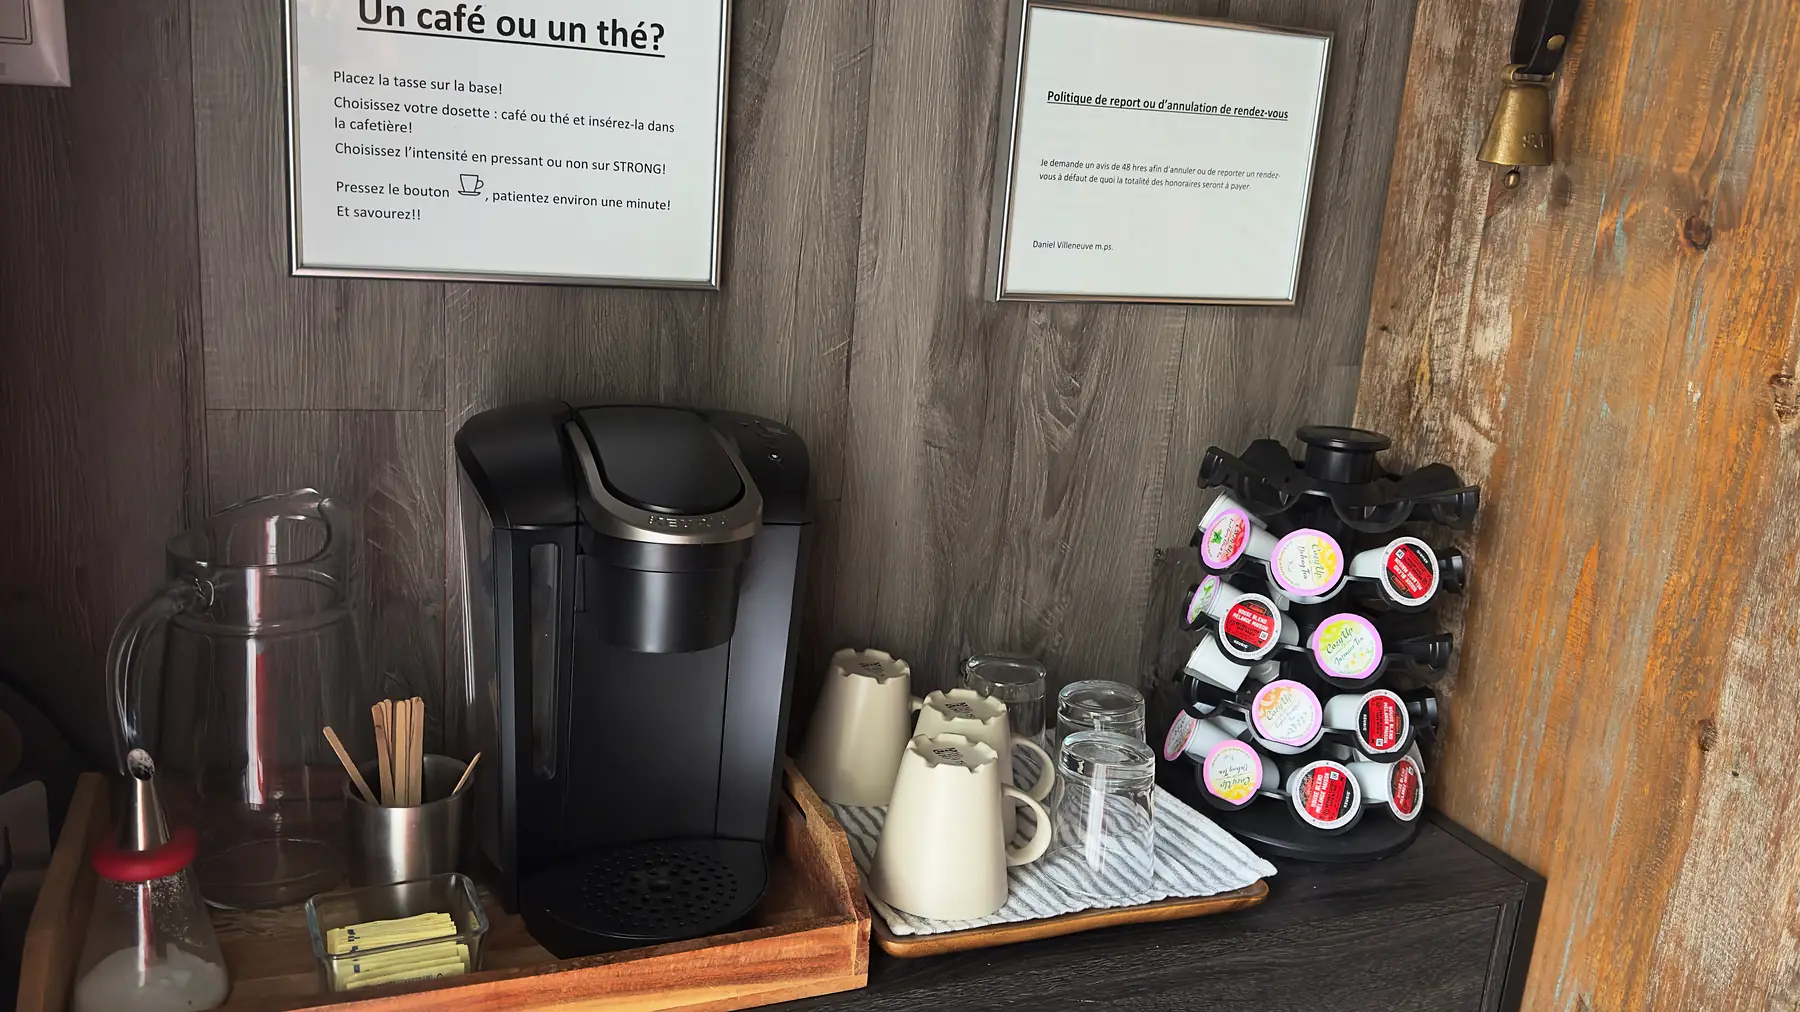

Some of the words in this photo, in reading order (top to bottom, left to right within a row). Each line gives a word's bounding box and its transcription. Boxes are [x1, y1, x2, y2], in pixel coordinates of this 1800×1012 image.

[358, 0, 405, 27] Un
[416, 3, 486, 34] café
[496, 15, 536, 38] ou
[548, 20, 586, 43] un
[596, 19, 665, 51] thé?
[334, 71, 374, 85] Placez
[379, 73, 390, 86] la
[393, 76, 426, 89] tasse
[430, 81, 450, 90] sur
[454, 79, 464, 92] la
[469, 80, 502, 95] base!
[334, 96, 400, 112] Choisissez
[404, 103, 438, 115] votre
[442, 104, 490, 119] dosette
[501, 109, 527, 122] café
[530, 113, 546, 123] ou
[550, 112, 570, 125] thé
[573, 116, 585, 126] et
[589, 115, 644, 130] insérez-la
[648, 120, 674, 133] dans
[1047, 90, 1092, 105] Politique
[1095, 94, 1107, 105] de
[1110, 97, 1140, 109] report
[1143, 100, 1156, 109] ou
[1158, 100, 1218, 114] d’annulation
[1220, 104, 1232, 115] de
[1234, 106, 1288, 119] rendez-vous
[334, 117, 346, 129] la
[350, 118, 412, 133] cafetière!
[335, 142, 401, 158] Choisissez
[405, 146, 468, 162] l’intensité
[472, 153, 487, 163] en
[491, 155, 543, 167] pressant
[546, 158, 562, 168] ou
[566, 160, 588, 170] non
[592, 162, 610, 171] sur
[613, 160, 666, 175] STRONG!
[1040, 158, 1048, 167] Je
[1049, 158, 1084, 169] demande
[1096, 162, 1110, 170] avis
[1111, 162, 1120, 171] de
[1122, 163, 1131, 172] 48
[1132, 163, 1148, 172] hres
[1148, 164, 1162, 173] afin
[1163, 165, 1196, 175] d’annuler
[1207, 167, 1216, 176] de
[1217, 170, 1245, 178] reporter
[1256, 171, 1281, 179] rendez-
[1039, 173, 1056, 181] vous
[1063, 173, 1088, 182] défaut
[1088, 174, 1098, 183] de
[1099, 175, 1116, 184] quoi
[1116, 176, 1123, 184] la
[1124, 177, 1150, 186] totalité
[1151, 178, 1164, 186] des
[1164, 178, 1201, 188] honoraires
[1230, 183, 1250, 191] payer.
[336, 181, 384, 194] Pressez
[388, 183, 400, 195] le
[404, 184, 450, 198] bouton
[492, 190, 549, 204] patientez
[552, 194, 598, 206] environ
[601, 199, 623, 208] une
[626, 198, 670, 211] minute!
[337, 205, 350, 217] Et
[354, 208, 420, 220] savourez!!
[1032, 240, 1056, 249] Daniel
[1056, 241, 1094, 250] Villeneuve
[1094, 244, 1114, 252] m.ps.
[1324, 636, 1344, 654] Cozy
